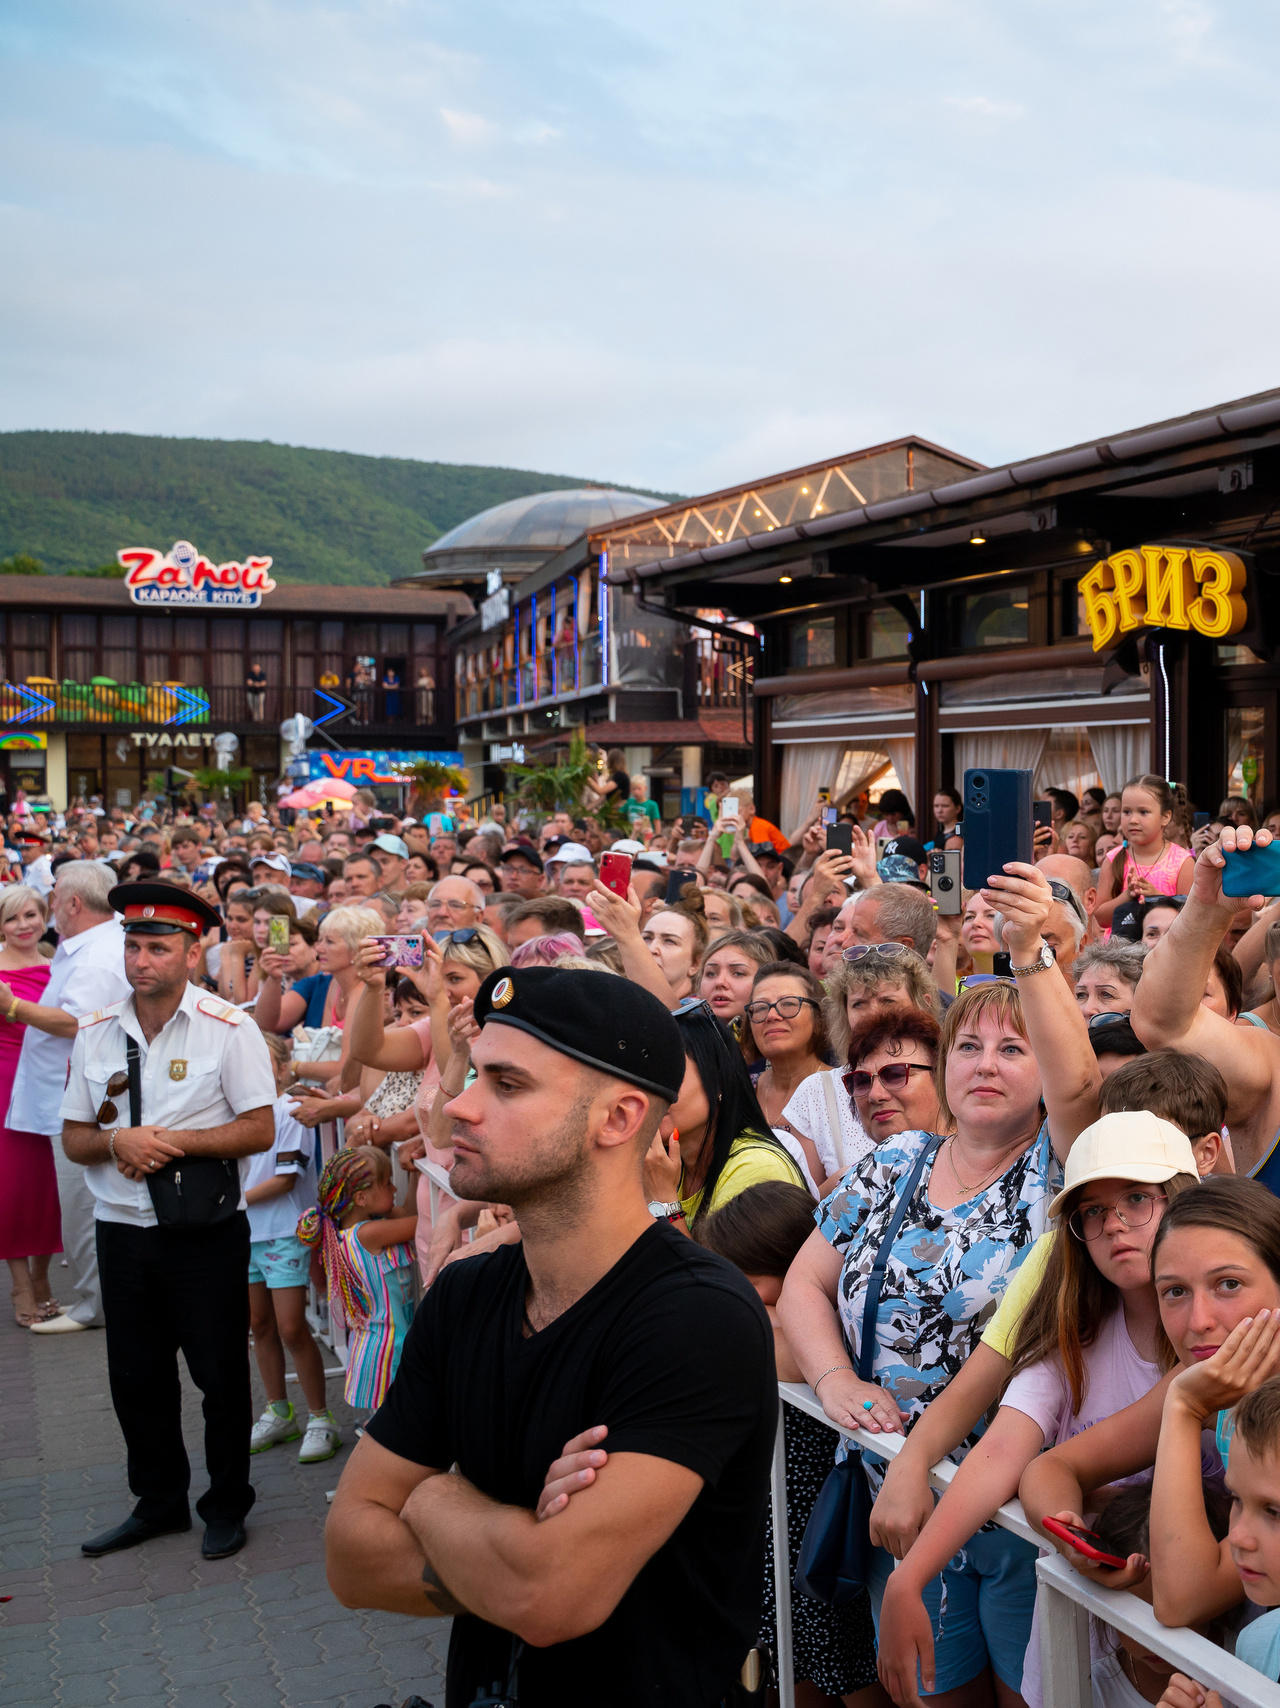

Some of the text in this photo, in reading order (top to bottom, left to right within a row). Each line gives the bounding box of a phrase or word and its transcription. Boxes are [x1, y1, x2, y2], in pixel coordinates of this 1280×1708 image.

[138, 588, 253, 604] КАРАОКЕ КЛУБ
[1077, 544, 1243, 653] БРИЗ
[130, 732, 215, 747] ТУАЛЕТ
[320, 753, 395, 782] VR
